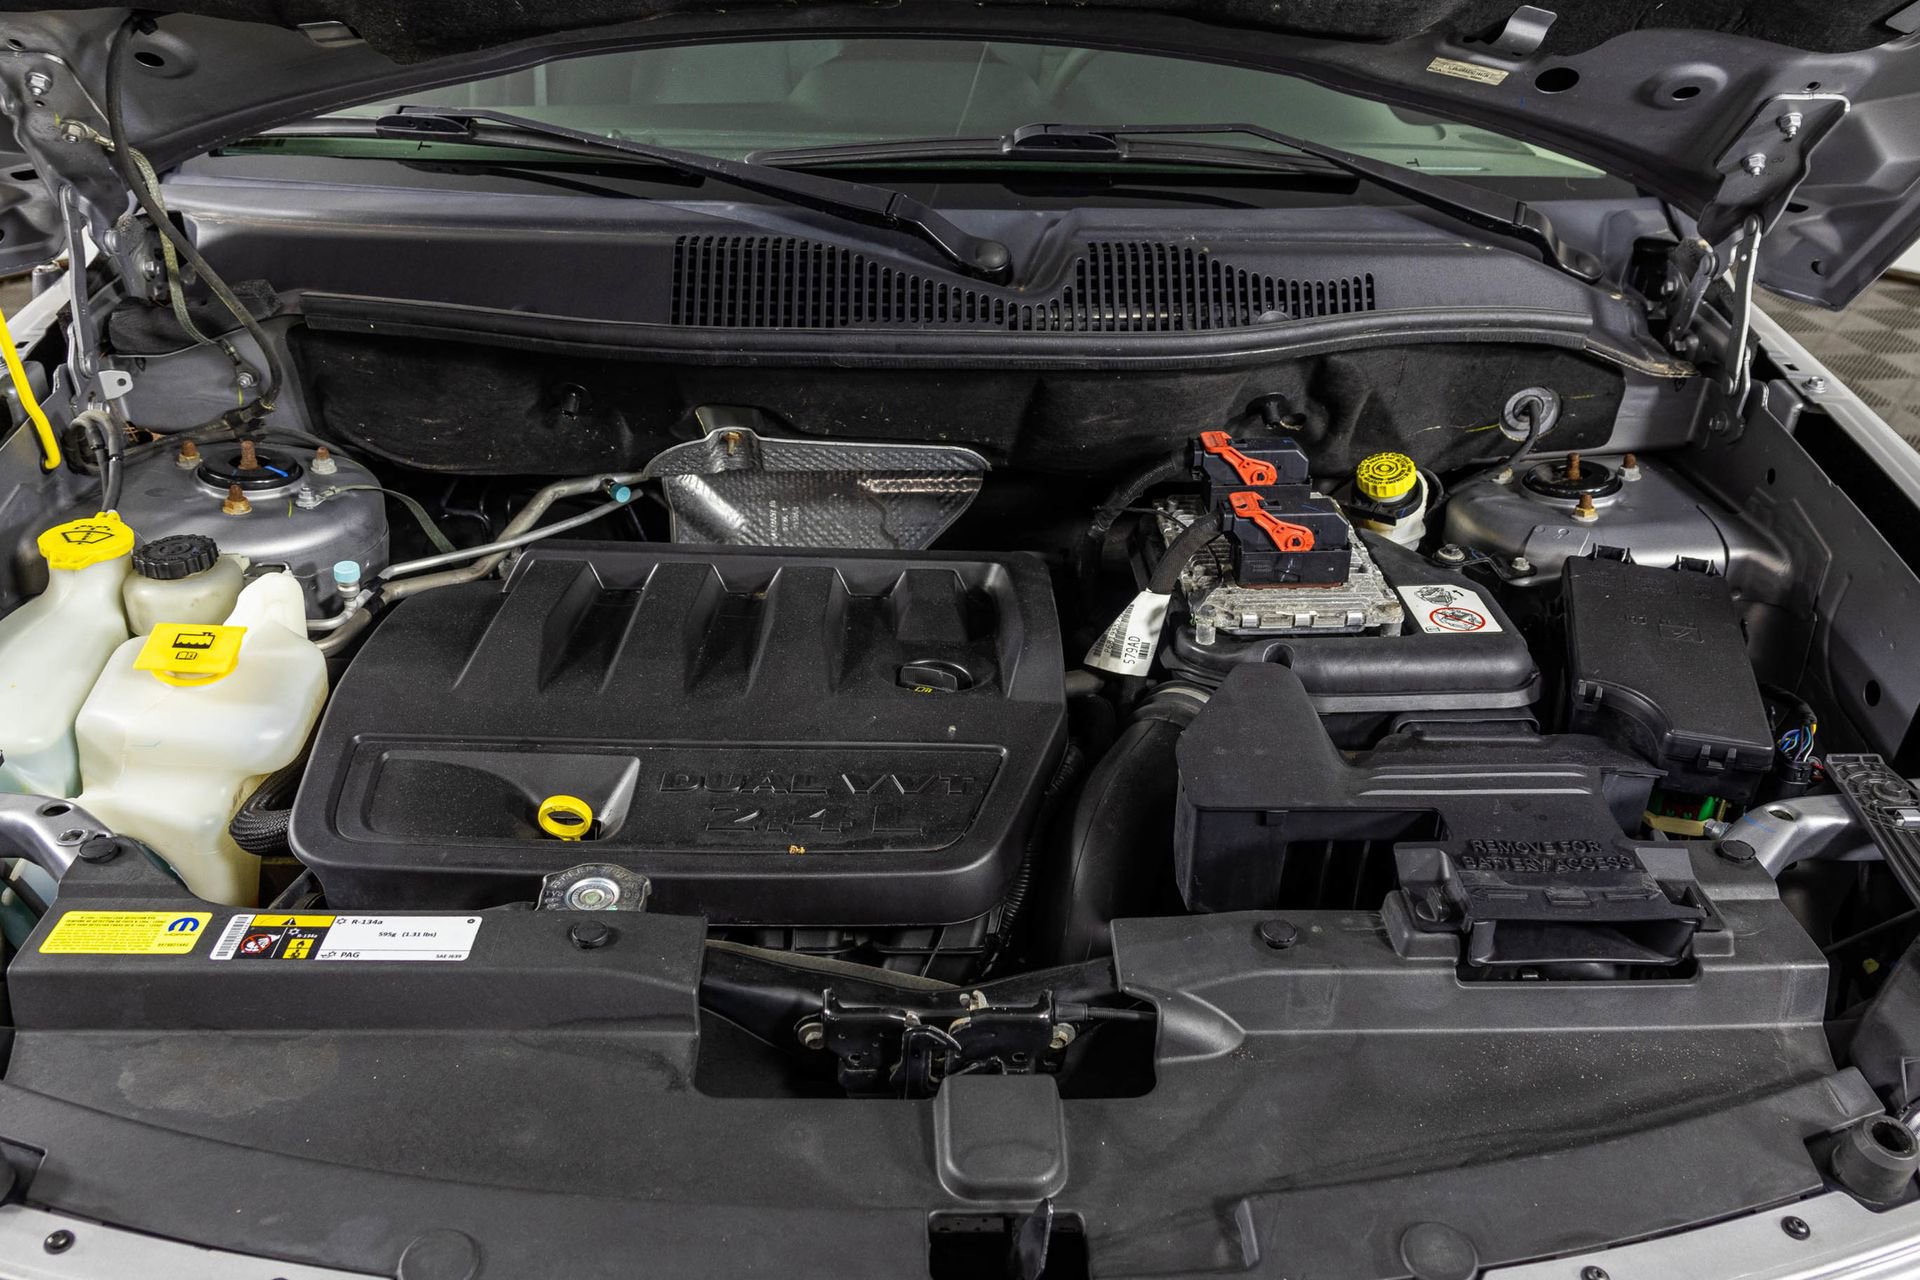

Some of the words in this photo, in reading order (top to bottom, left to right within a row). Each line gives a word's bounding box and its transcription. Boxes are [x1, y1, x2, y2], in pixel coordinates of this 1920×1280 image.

[1123, 635, 1141, 665] 579AD
[659, 772, 828, 795] DUAL
[841, 773, 975, 796] VVT
[1470, 839, 1557, 856] REMOVE
[1558, 839, 1602, 856] FOR
[1461, 855, 1552, 873] BATTERY
[1556, 854, 1635, 873] ACCESS
